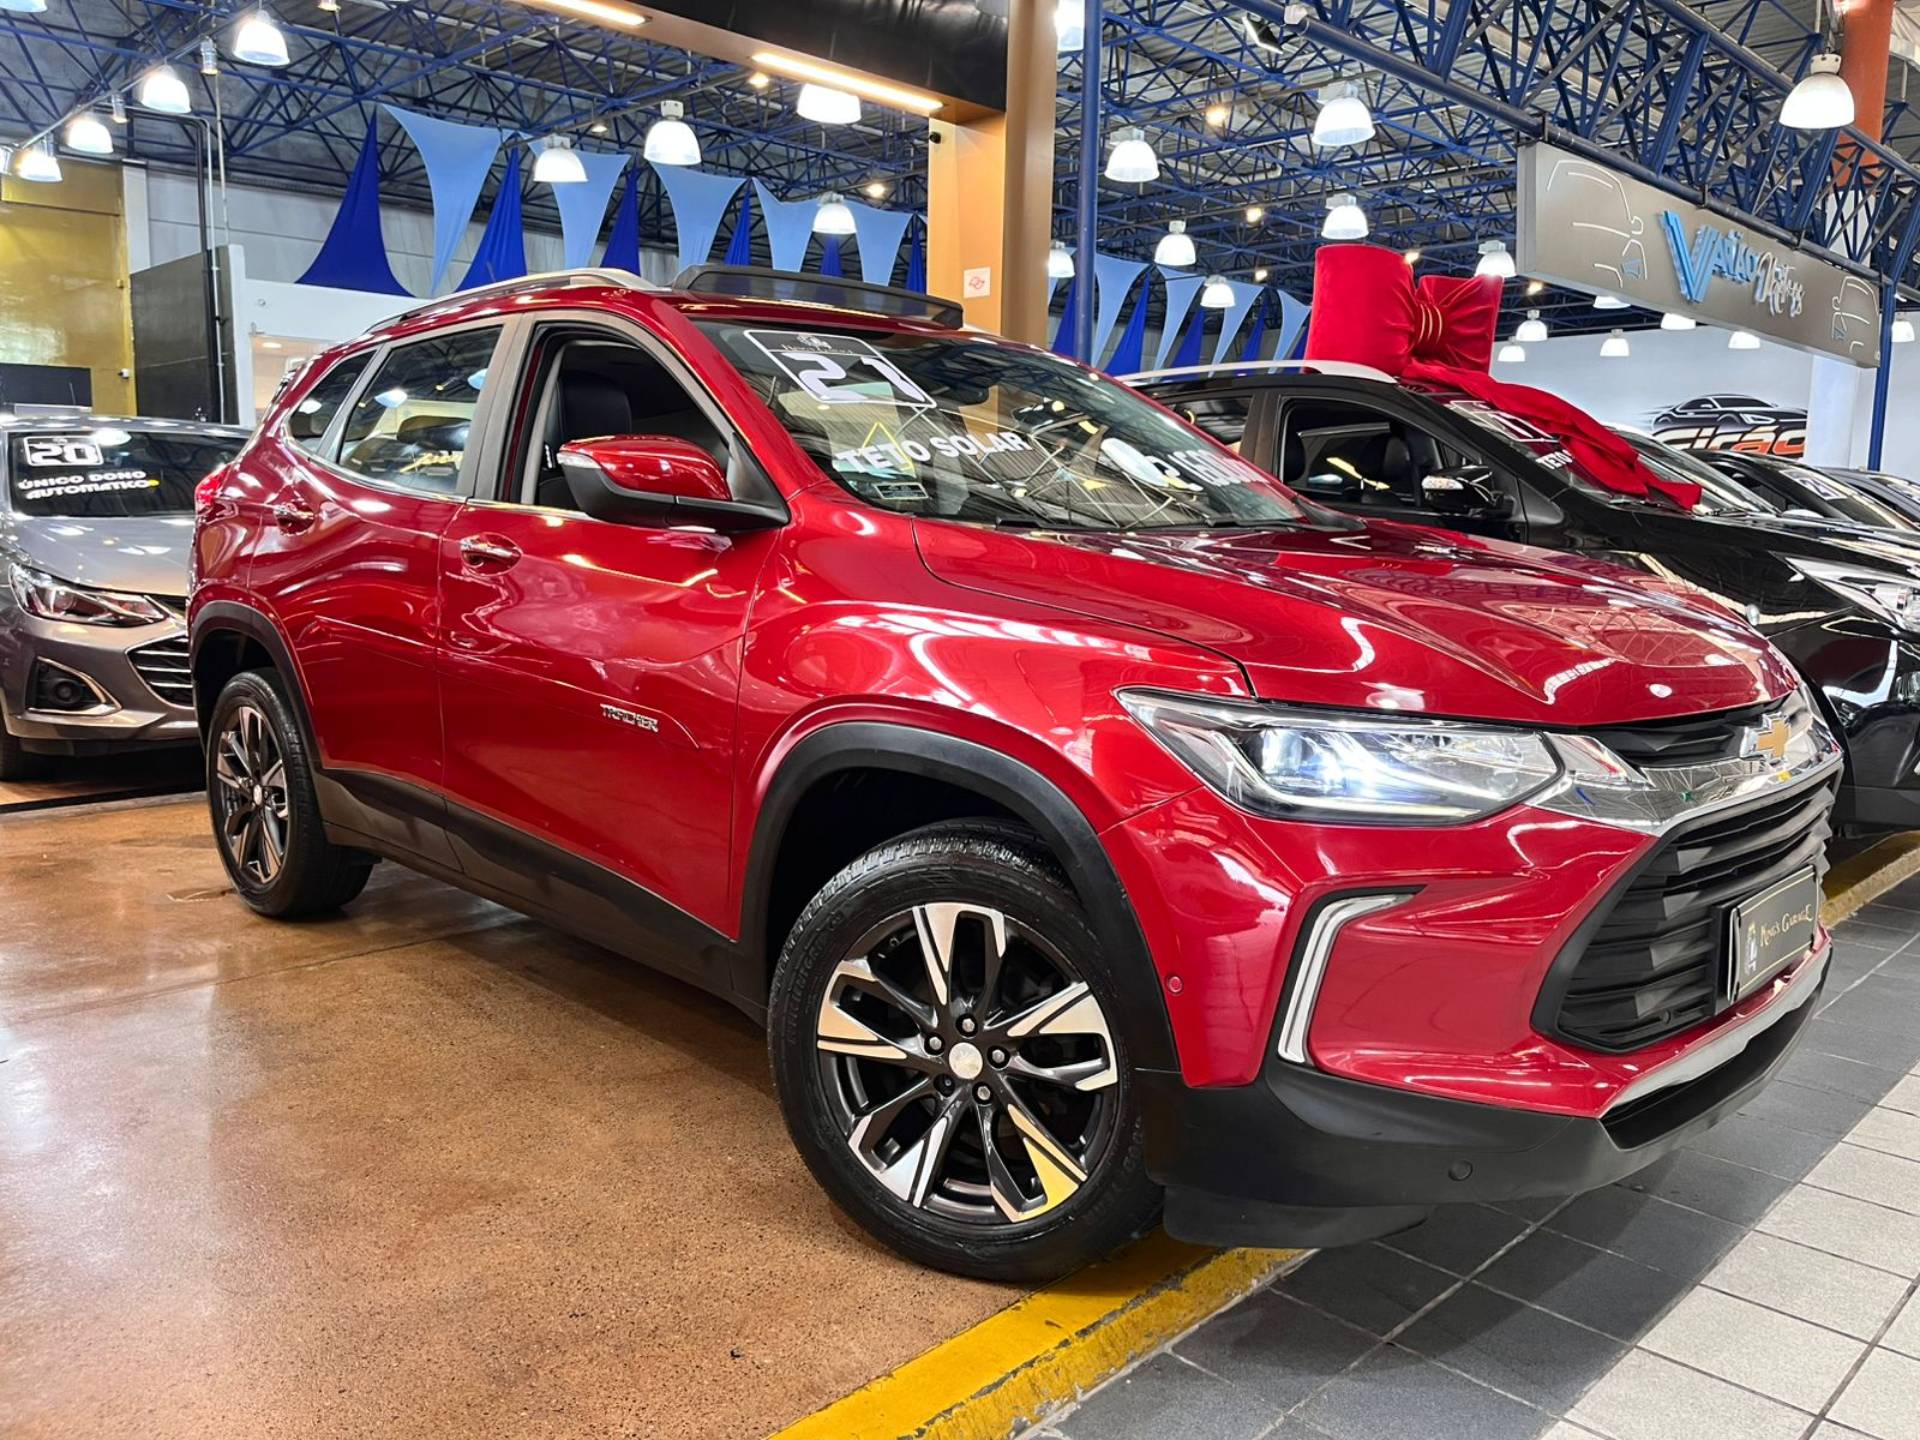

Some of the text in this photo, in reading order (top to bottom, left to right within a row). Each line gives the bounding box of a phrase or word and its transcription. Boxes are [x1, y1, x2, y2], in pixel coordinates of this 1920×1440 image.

[780, 352, 926, 402] 21
[28, 442, 99, 465] 20
[835, 431, 1033, 474] TETO SOLAR
[17, 470, 147, 490] ÚNICO DONO
